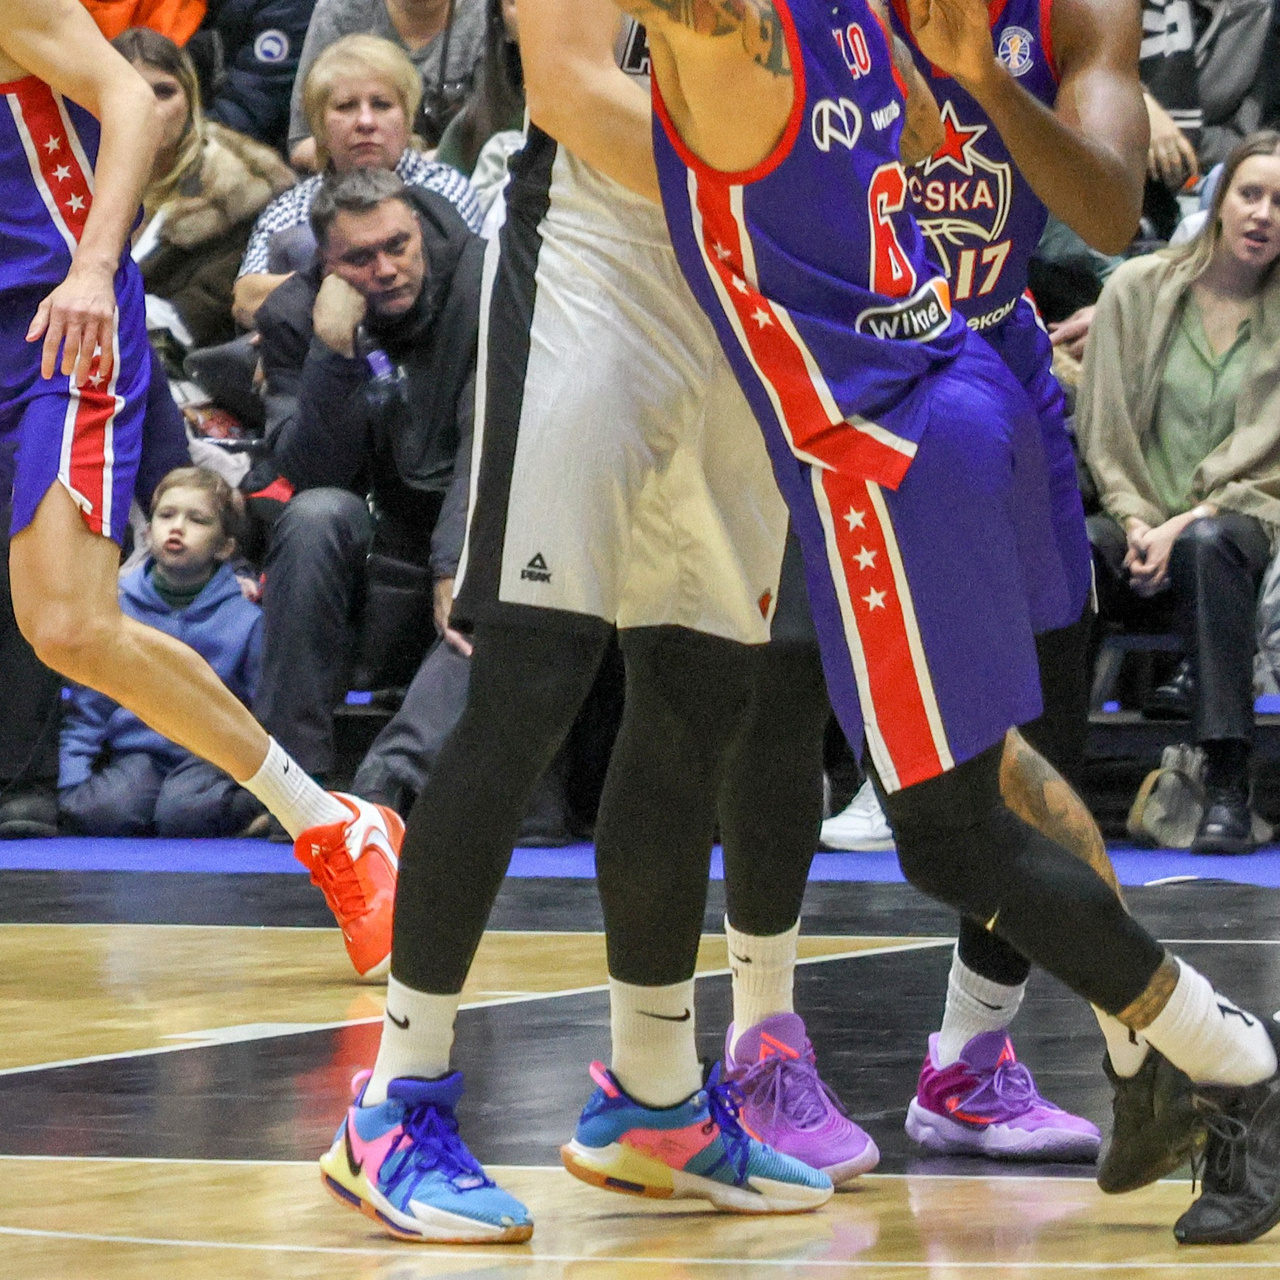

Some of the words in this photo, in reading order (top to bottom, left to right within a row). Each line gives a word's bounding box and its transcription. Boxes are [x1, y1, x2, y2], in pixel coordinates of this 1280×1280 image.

[908, 175, 996, 212] CSKA
[868, 161, 917, 298] 6
[955, 239, 1012, 300] 17
[966, 297, 1017, 331] еком
